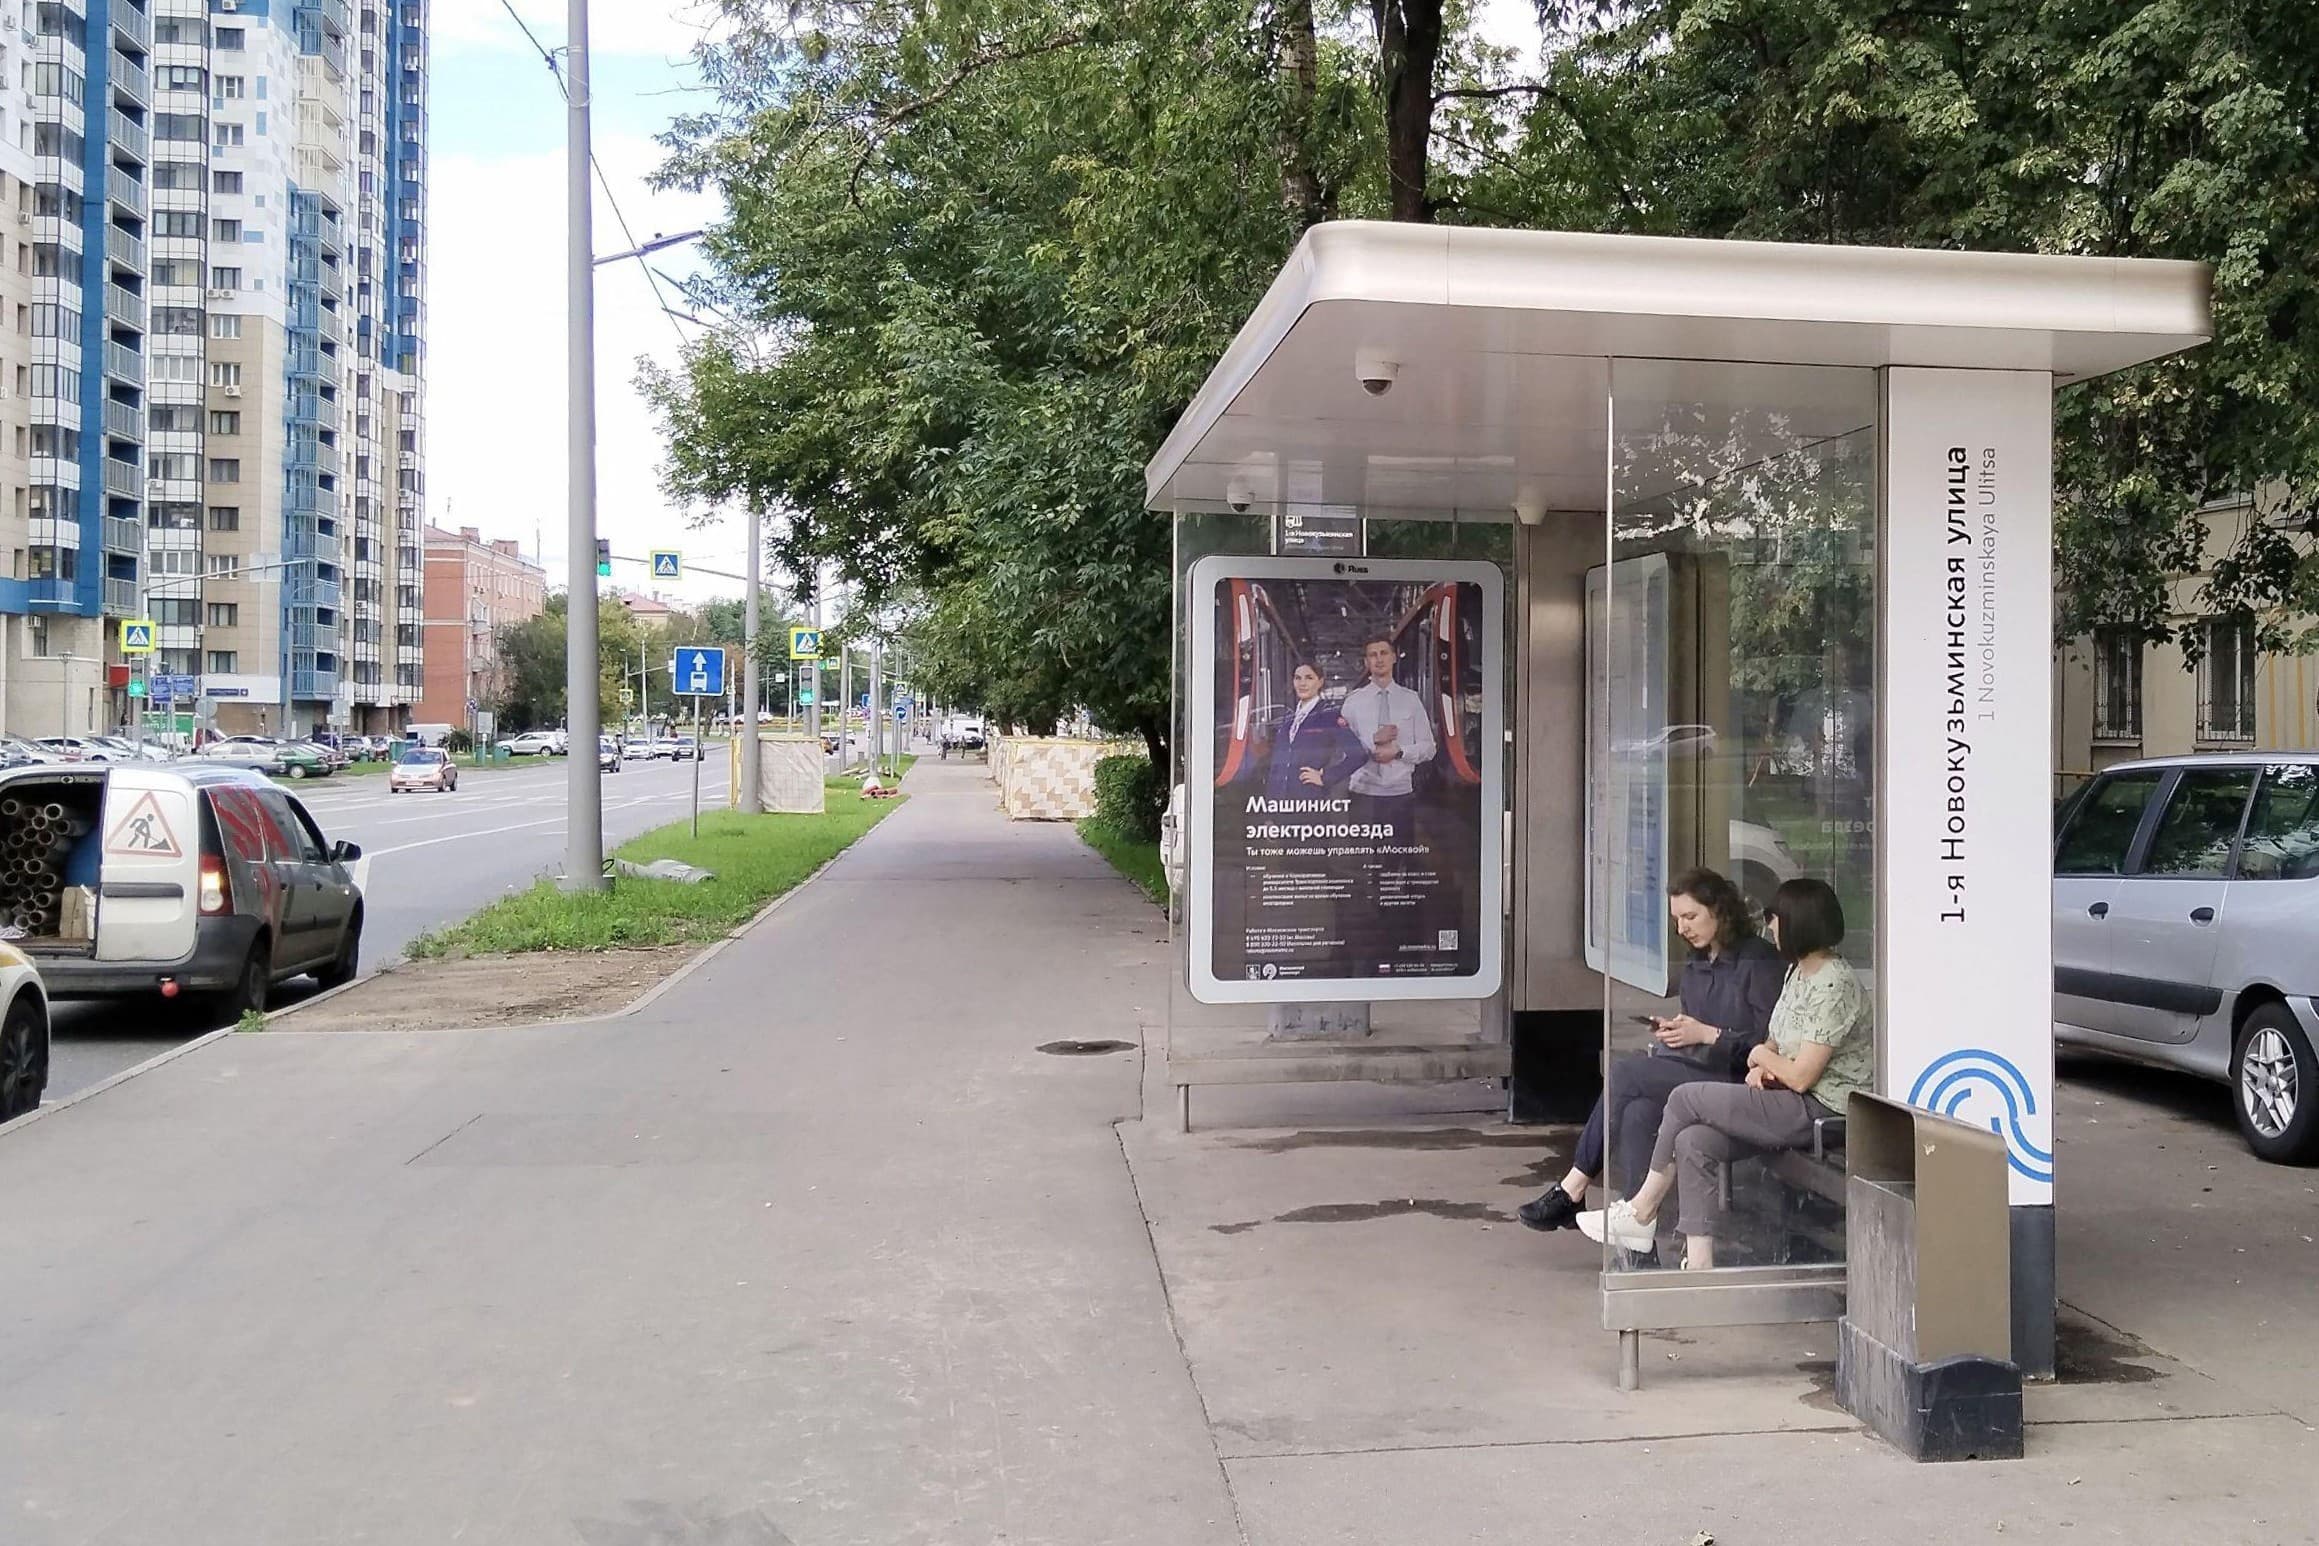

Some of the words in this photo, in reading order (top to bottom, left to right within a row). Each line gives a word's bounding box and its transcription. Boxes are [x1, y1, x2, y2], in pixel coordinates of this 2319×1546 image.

[1948, 447, 1971, 544] улица
[1978, 448, 1996, 506] Ulitsa
[1977, 513, 1999, 702] Novokuzminskaya
[1941, 558, 1971, 860] Новокузьминская
[1978, 711, 1995, 721] 1
[1245, 796, 1351, 813] Машинист
[1245, 823, 1394, 841] электропоезда
[1246, 847, 1258, 857] Ты
[1260, 847, 1284, 856] тоже
[1286, 847, 1326, 856] можешь
[1327, 845, 1375, 857] управлять
[1941, 875, 1965, 922] 1-я
